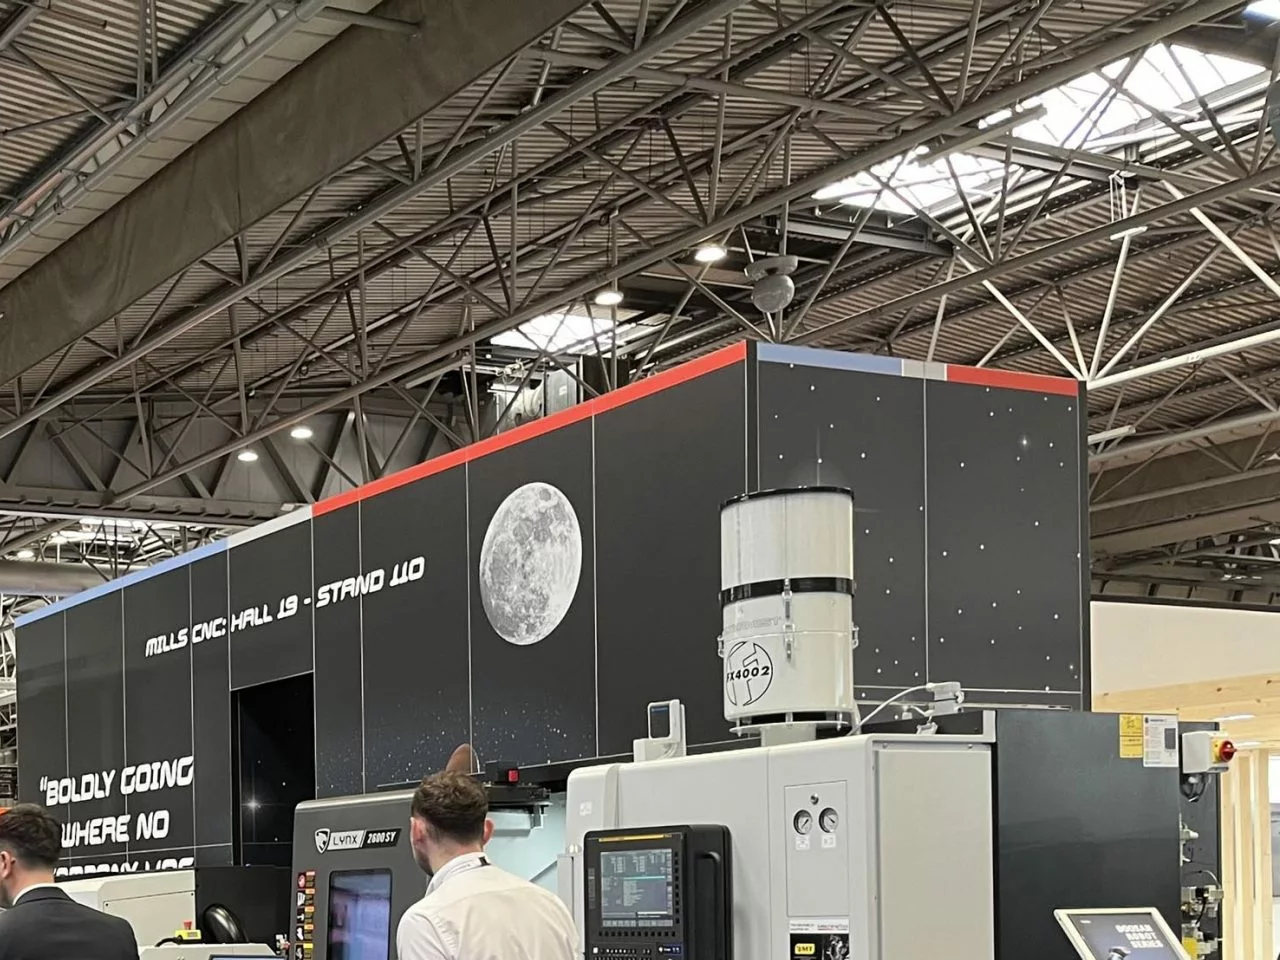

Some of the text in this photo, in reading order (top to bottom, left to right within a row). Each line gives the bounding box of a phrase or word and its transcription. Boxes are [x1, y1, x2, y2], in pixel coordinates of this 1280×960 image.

[145, 627, 188, 658] MILLS
[191, 616, 227, 644] CNC:
[230, 603, 273, 633] HALL
[277, 594, 298, 620] 19
[315, 568, 385, 609] STAND
[389, 556, 426, 588] 110
[39, 755, 194, 807] "BOLDLY GOING
[61, 809, 170, 849] WHERE NO
